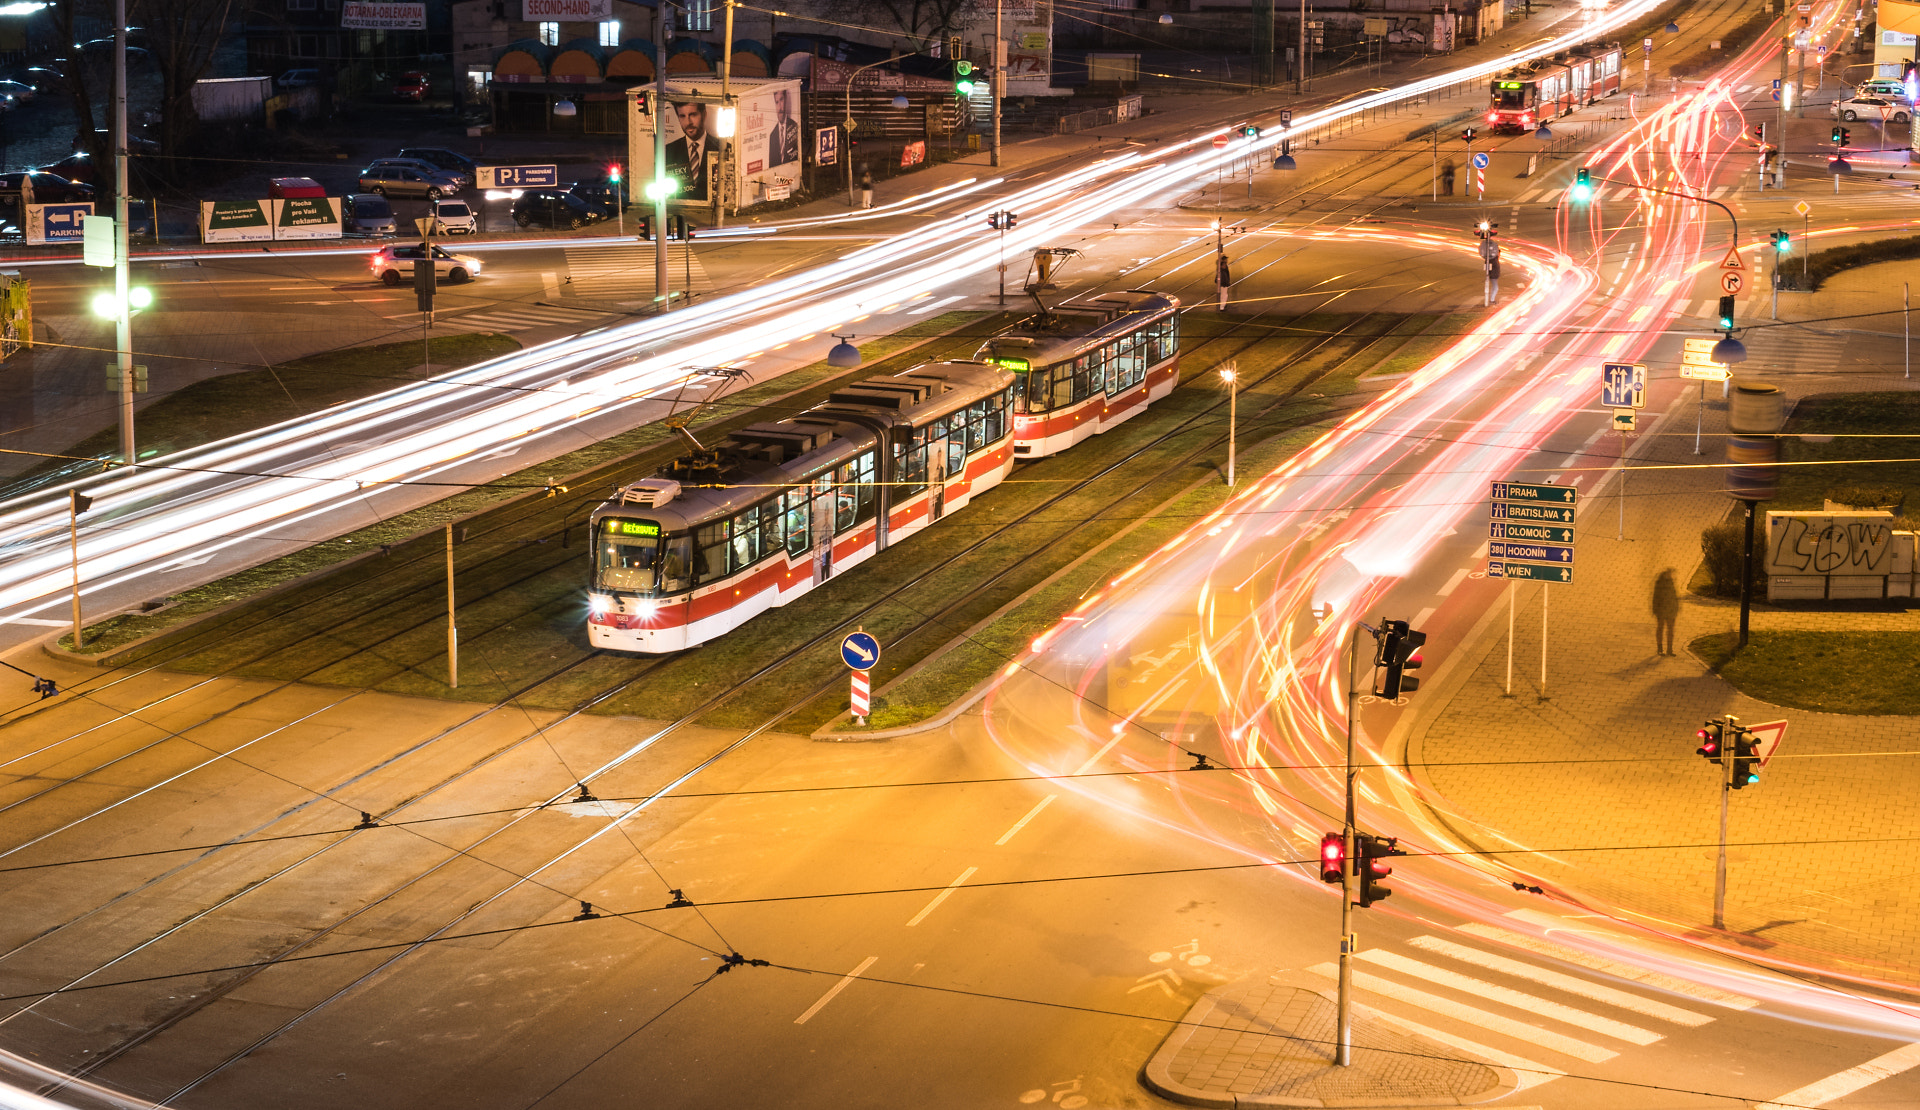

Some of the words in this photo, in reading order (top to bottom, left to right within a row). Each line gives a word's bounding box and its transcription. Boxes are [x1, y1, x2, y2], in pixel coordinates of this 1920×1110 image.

[528, 0, 590, 15] SECOND-HAND
[500, 169, 512, 184] P
[73, 210, 87, 226] P
[293, 217, 322, 225] reklamu
[1510, 487, 1538, 498] PRAHA
[1509, 507, 1559, 519] BRATISLAVA
[623, 522, 659, 535] ŘEČKOVICE
[1508, 527, 1551, 538] OLOMOUC
[1491, 545, 1504, 554] 380
[1507, 546, 1547, 557] HODONÍN
[1773, 517, 1892, 573] LOW
[1507, 566, 1532, 576] WIEN
